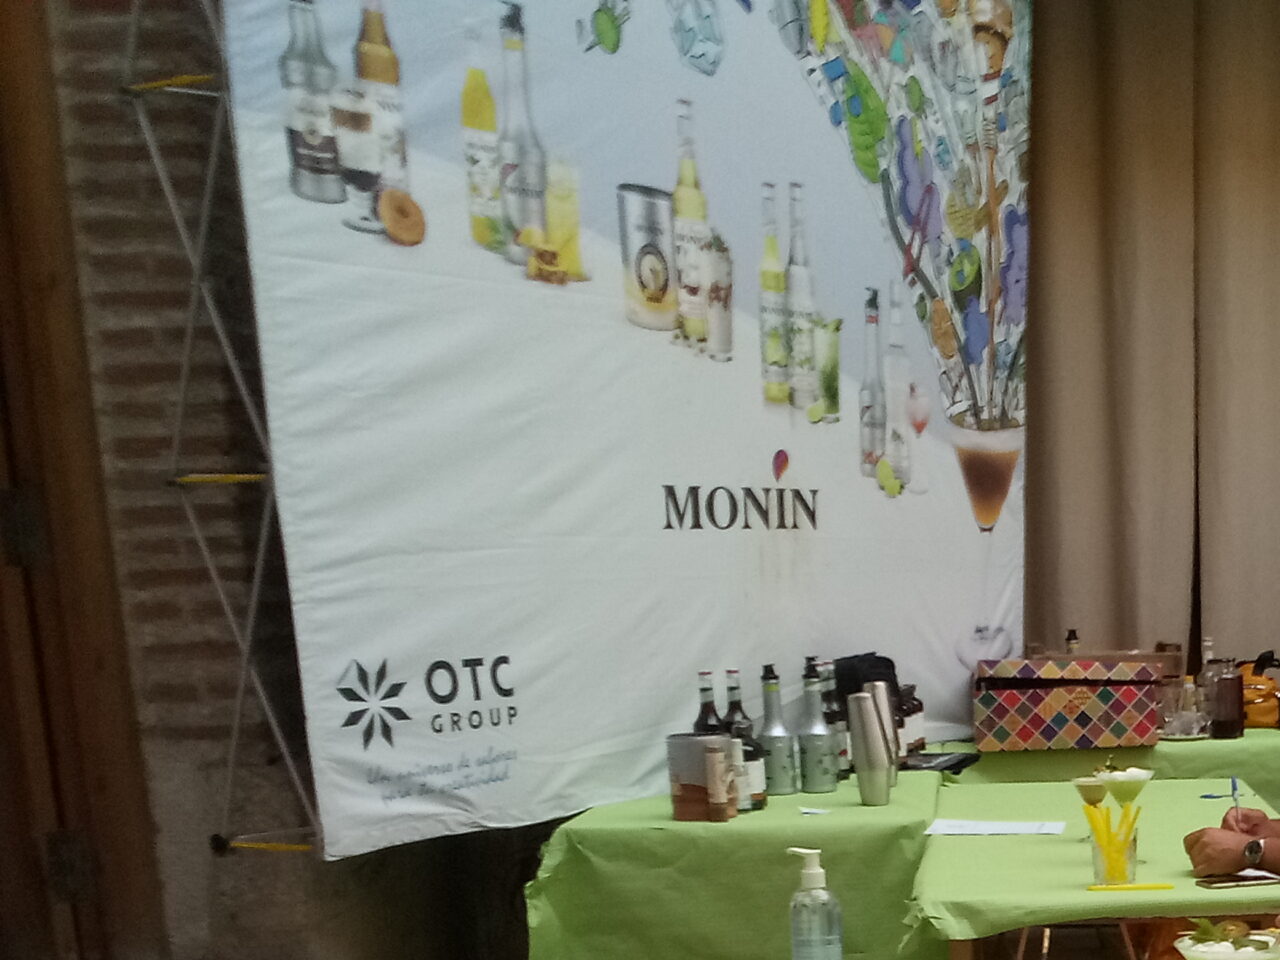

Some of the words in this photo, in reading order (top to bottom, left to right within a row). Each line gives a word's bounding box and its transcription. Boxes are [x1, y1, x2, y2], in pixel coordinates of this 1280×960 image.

[662, 485, 819, 530] MONIN
[425, 655, 514, 704] OTC
[431, 706, 518, 733] GROUP
